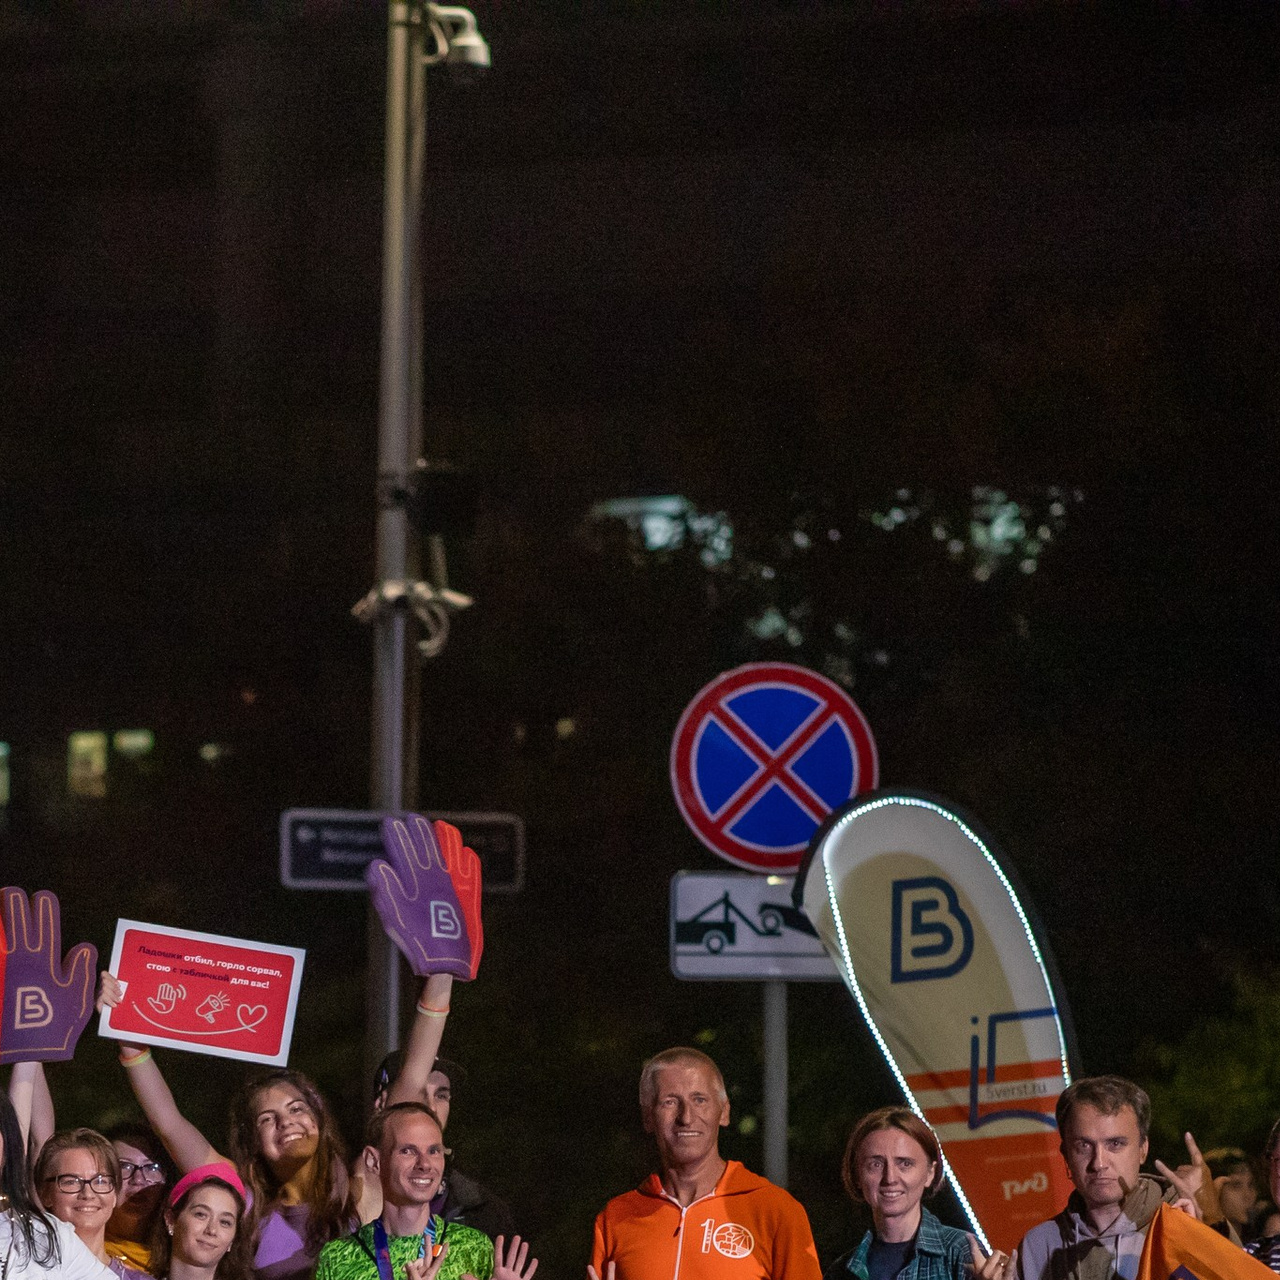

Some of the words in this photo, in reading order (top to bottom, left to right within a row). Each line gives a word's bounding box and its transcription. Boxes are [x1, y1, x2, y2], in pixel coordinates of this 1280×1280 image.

[137, 945, 182, 961] Ладошки
[183, 953, 216, 968] отбил,
[216, 959, 246, 972] горло
[246, 964, 283, 979] сорвал,
[146, 961, 172, 974] стою
[179, 967, 230, 983] табличкой
[229, 976, 250, 987] для
[250, 979, 270, 990] вас!
